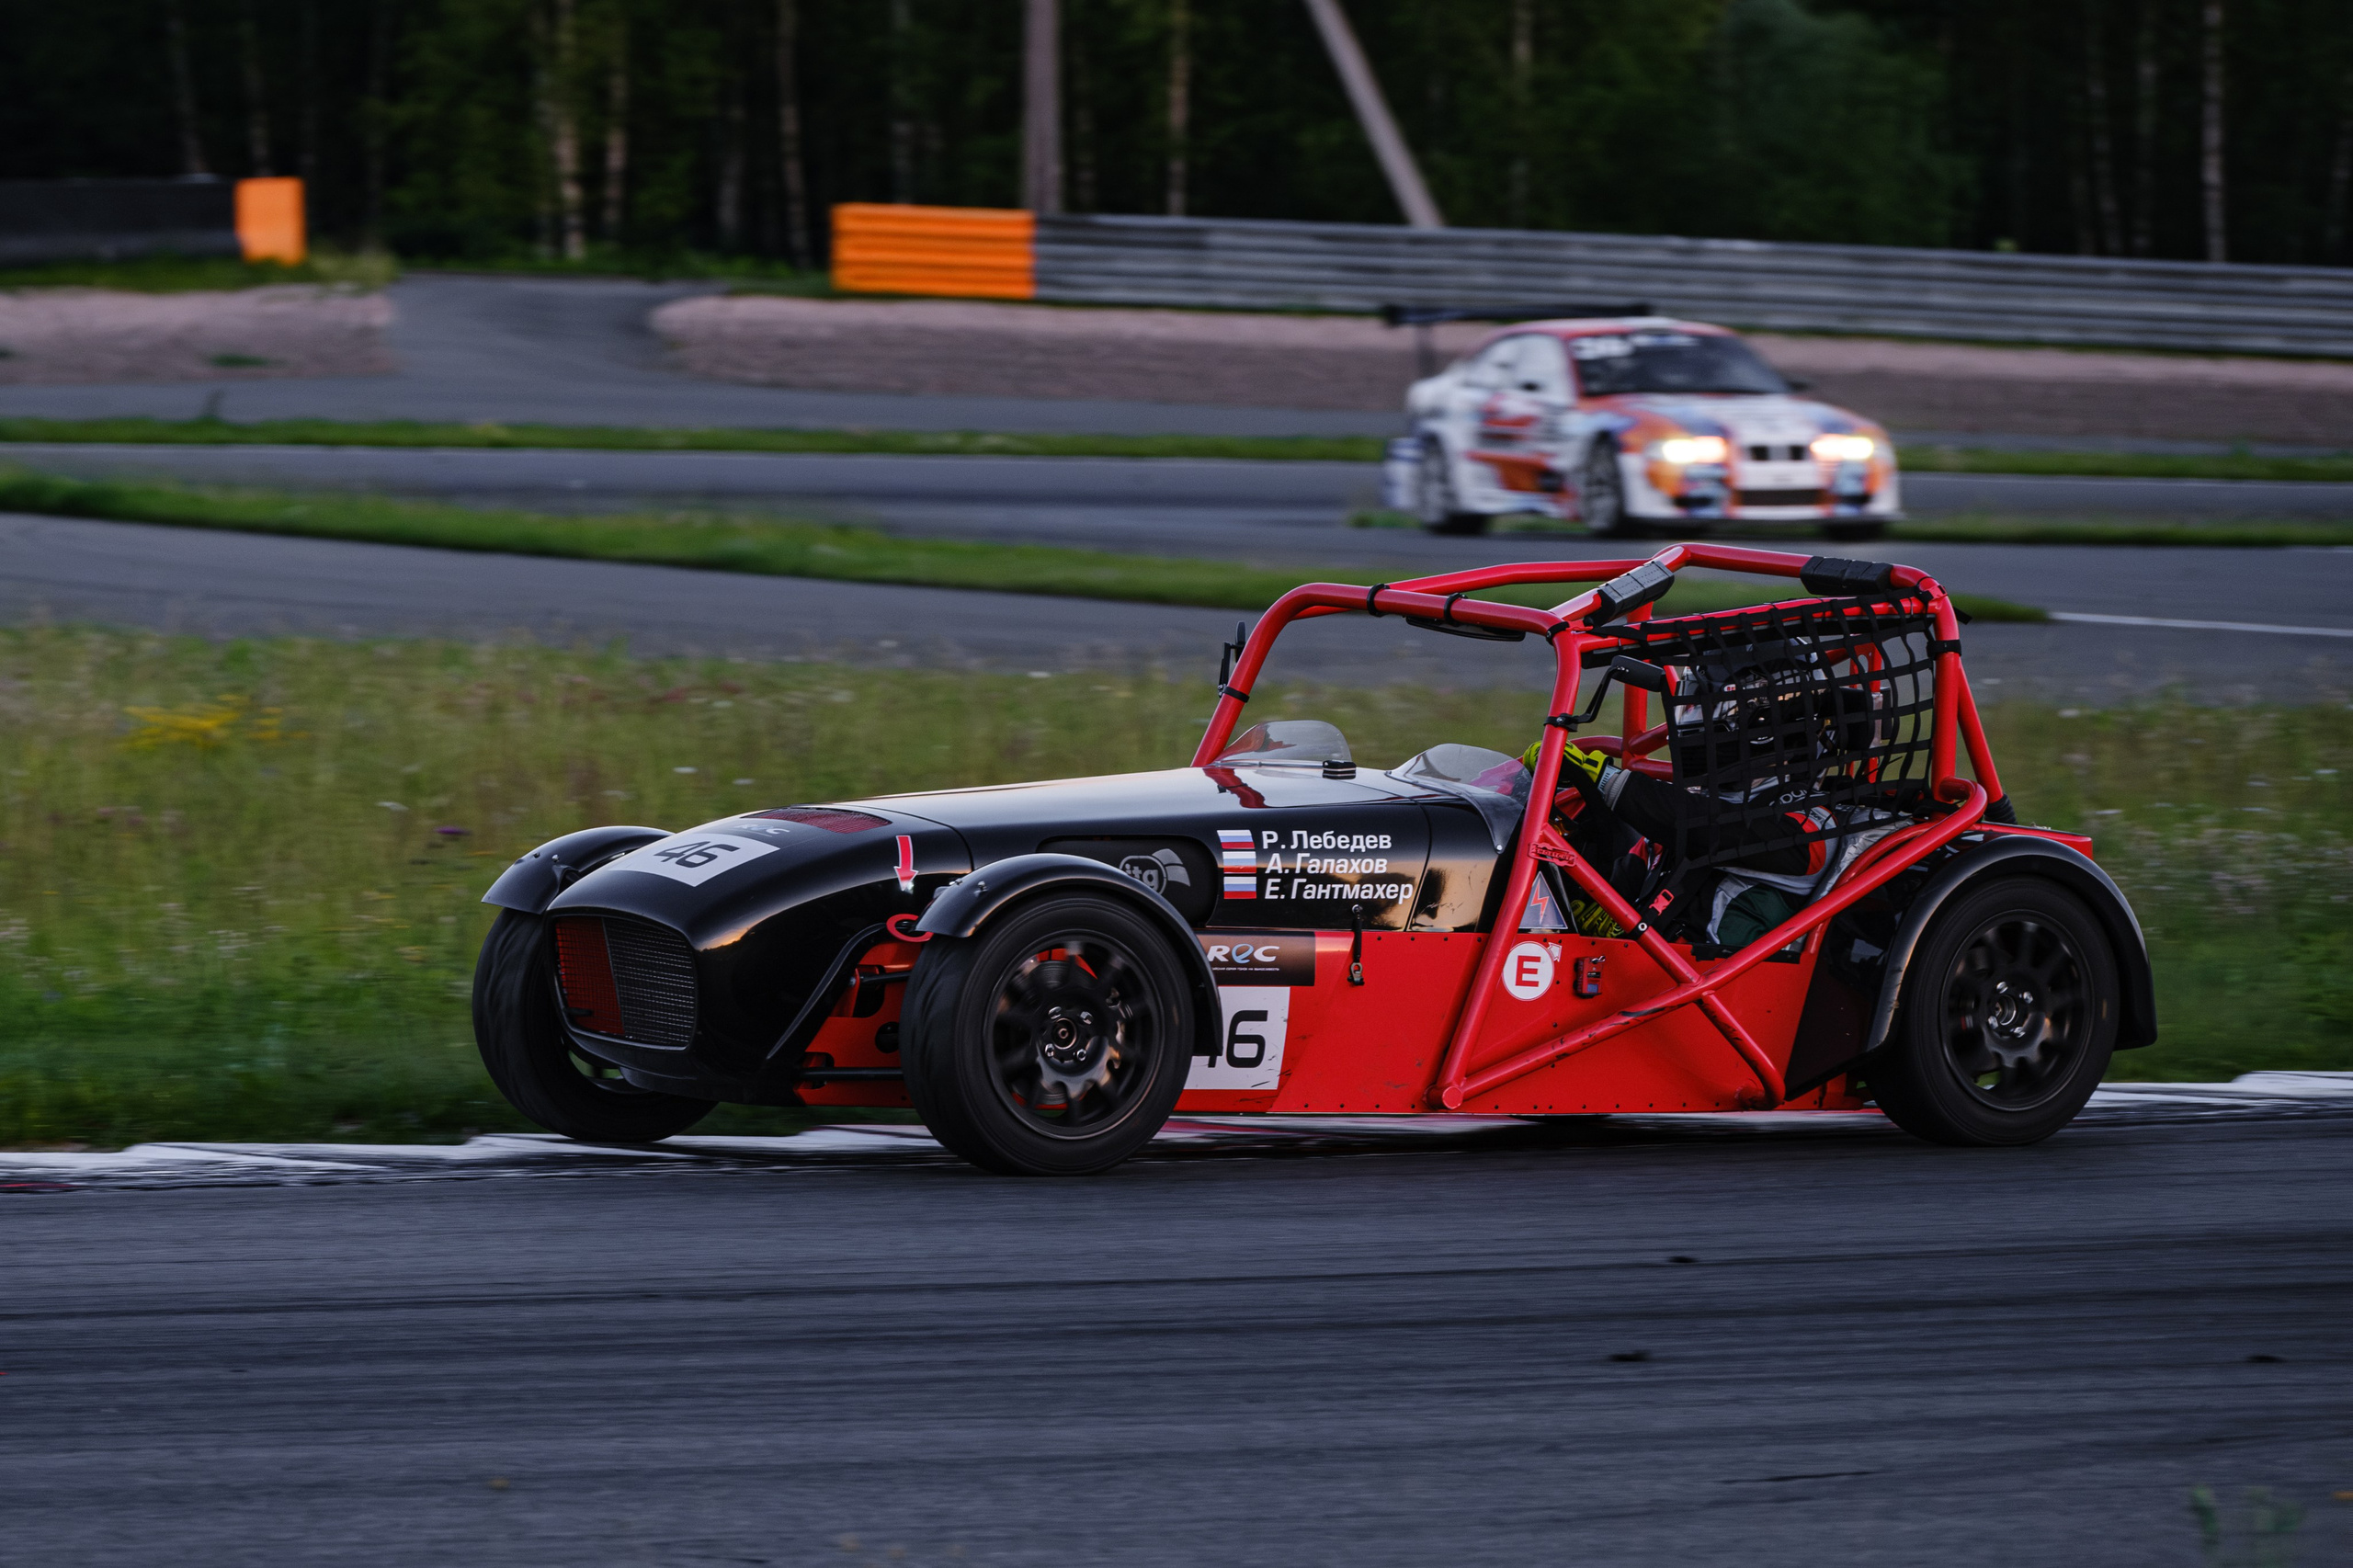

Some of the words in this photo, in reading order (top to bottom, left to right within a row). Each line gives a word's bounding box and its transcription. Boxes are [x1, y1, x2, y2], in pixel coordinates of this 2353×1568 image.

[1262, 830, 1285, 849] Р.
[1290, 830, 1392, 852] Лебедев
[654, 841, 741, 869] 46
[1266, 853, 1289, 873] А.
[1295, 853, 1388, 874] Галахов
[1265, 879, 1285, 900] Е.
[1291, 879, 1414, 904] Гантмахер
[1515, 956, 1540, 987] E
[1208, 1010, 1268, 1068] 6
